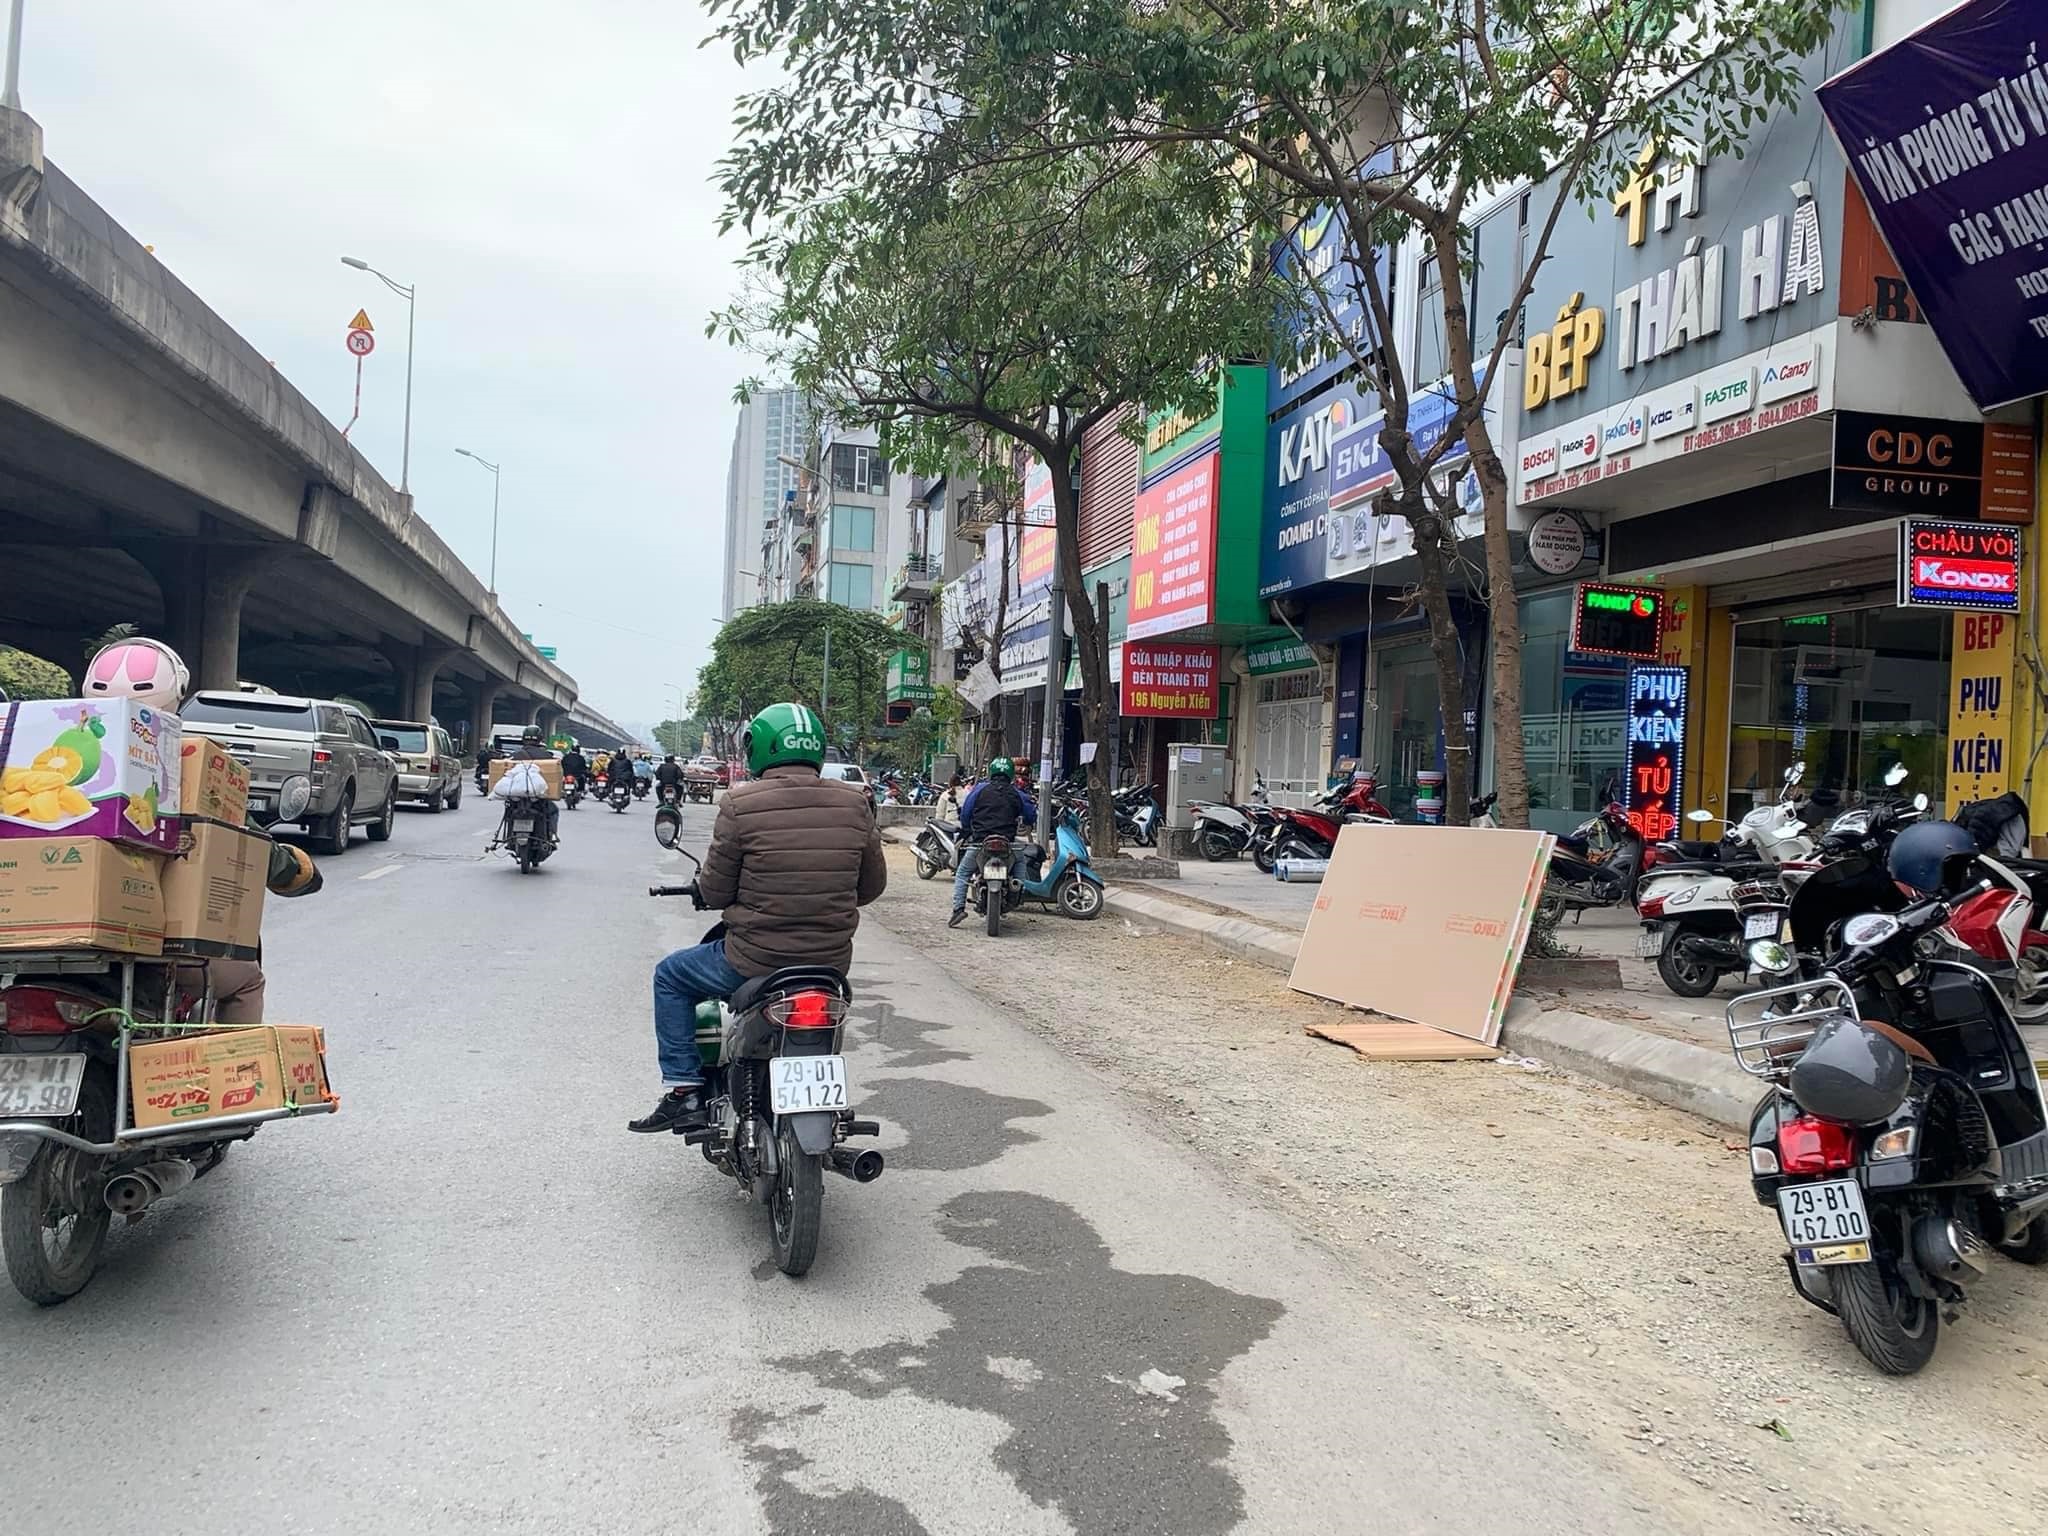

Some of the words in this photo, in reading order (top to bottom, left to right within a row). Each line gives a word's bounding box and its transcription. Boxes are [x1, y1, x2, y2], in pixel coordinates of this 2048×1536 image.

[1859, 136, 1917, 204] VĂN
[1899, 105, 1994, 189] PHÒNG
[1978, 77, 2026, 152] TƯ
[1949, 209, 2004, 265] CÁC
[1523, 291, 1605, 411] BẾP
[1616, 236, 1725, 371] THÁI
[1739, 180, 1824, 320] HÀ
[1779, 360, 1812, 381] Canzy
[1704, 380, 1748, 406] FASTER
[1523, 448, 1555, 471] BOSCH
[1562, 439, 1584, 454] FAGOR
[1867, 429, 1953, 467] CDC
[1865, 477, 1949, 496] GROUP
[1279, 523, 1316, 556] DOANH
[1916, 529, 1974, 556] CHẬU
[1980, 533, 2014, 556] VÒI
[1130, 648, 1151, 666] CỬA
[1154, 651, 1182, 670] NHẬP
[1185, 650, 1213, 668] KHẨU
[1132, 669, 1153, 685] ĐÈN
[1157, 673, 1190, 686] TRANG
[1192, 672, 1209, 687] TRÍ
[1636, 675, 1681, 707] PHỤ
[1130, 691, 1148, 707] 196
[1151, 691, 1186, 710] Nguyễn
[1960, 677, 2001, 720] PHỤ
[784, 735, 821, 751] Grab
[1630, 710, 1683, 748] KIỆN
[1953, 732, 2002, 780] KIỆN
[1638, 756, 1671, 794] TỦ
[1627, 800, 1676, 839] BẾP
[783, 1060, 835, 1083] 29-D1
[778, 1084, 844, 1109] 541.22
[1790, 1185, 1850, 1214] 29-B1
[1792, 1212, 1864, 1242] 462.00
